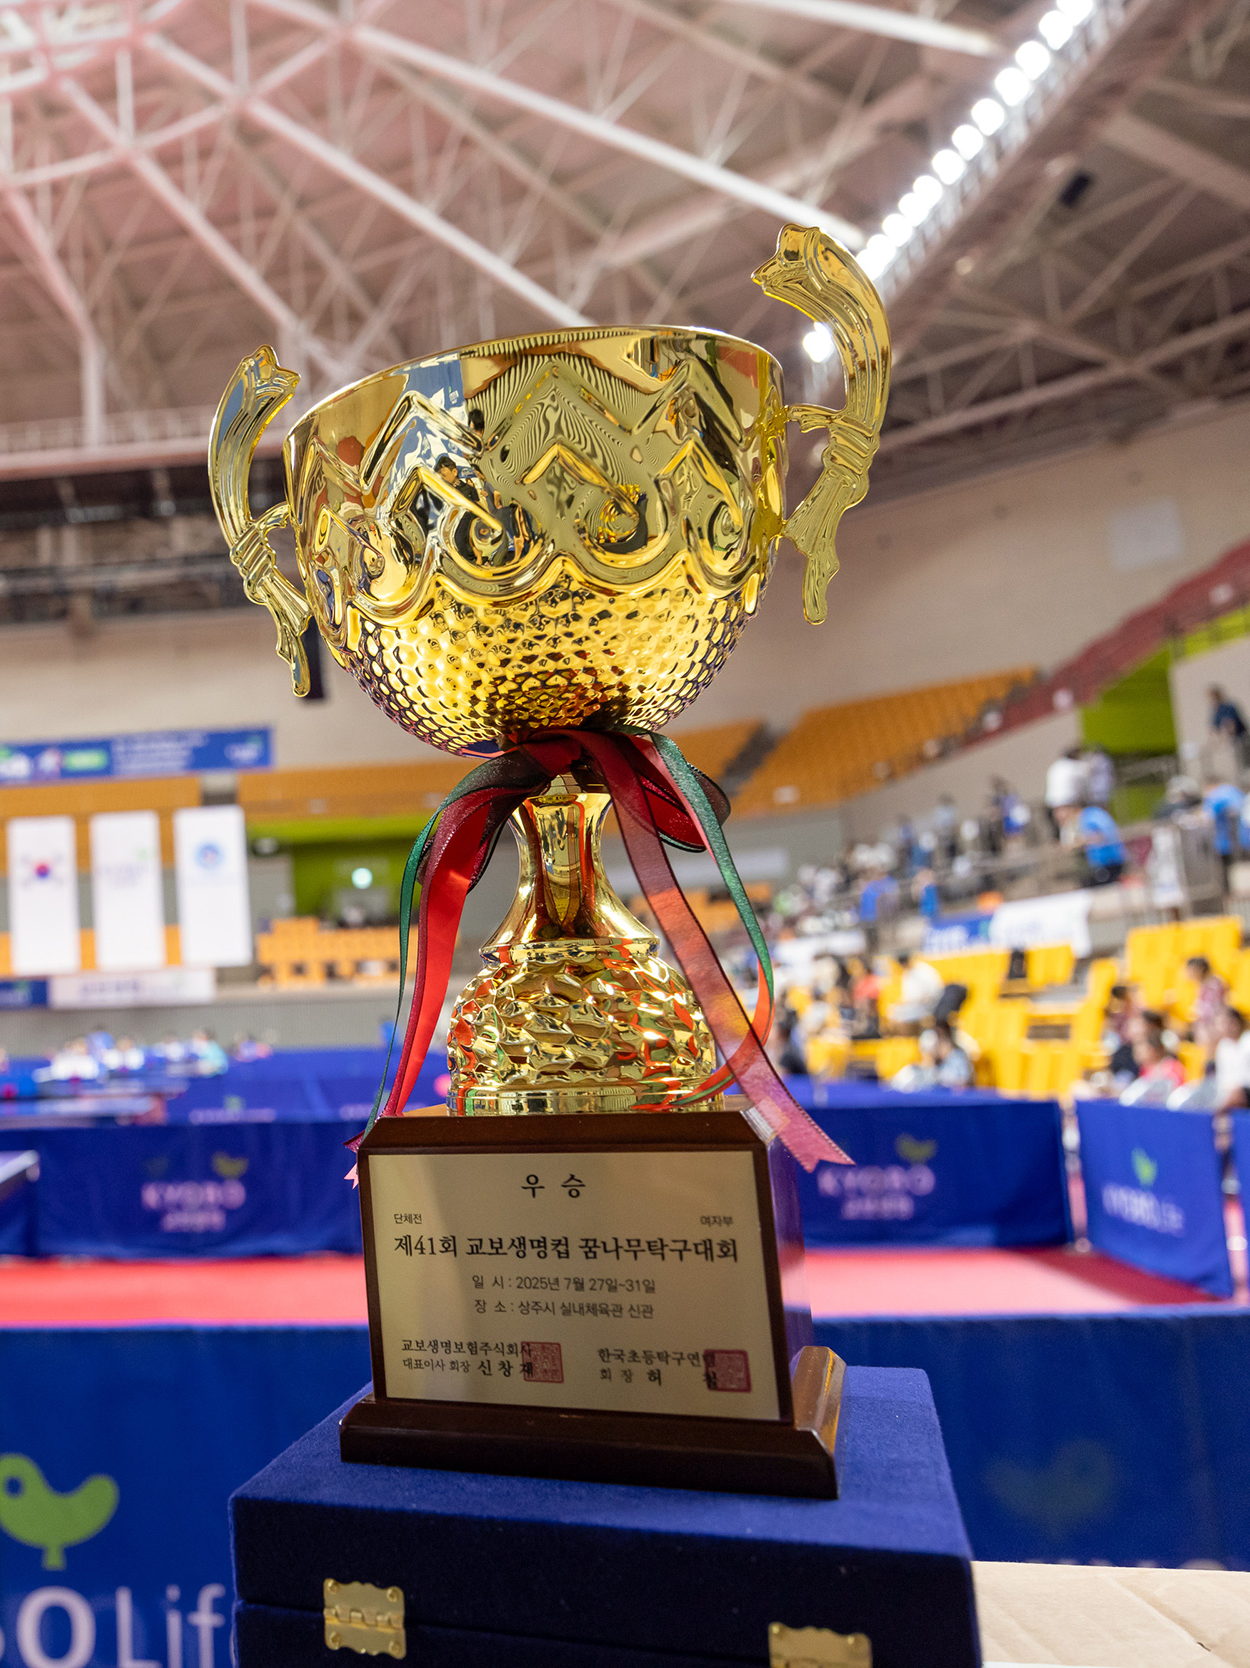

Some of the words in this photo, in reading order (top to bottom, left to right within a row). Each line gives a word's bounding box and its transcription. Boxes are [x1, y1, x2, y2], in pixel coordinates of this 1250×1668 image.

[393, 1213, 423, 1225] 단체전
[700, 1215, 734, 1227] 여자부
[393, 1233, 458, 1258] 제41회
[465, 1235, 571, 1260] 교보생명컵
[578, 1236, 738, 1263] 꿈나무탁구대회
[515, 1276, 561, 1292] 2025년
[563, 1276, 586, 1293] 7월
[588, 1277, 657, 1295] 27일~31일
[517, 1300, 556, 1316] 상주시
[559, 1301, 624, 1319] 실내체육관
[627, 1303, 655, 1320] 신관
[402, 1357, 446, 1373] 대표이사
[448, 1358, 471, 1374] 회장
[646, 1368, 663, 1386] 허
[116, 1583, 226, 1668] Lif
